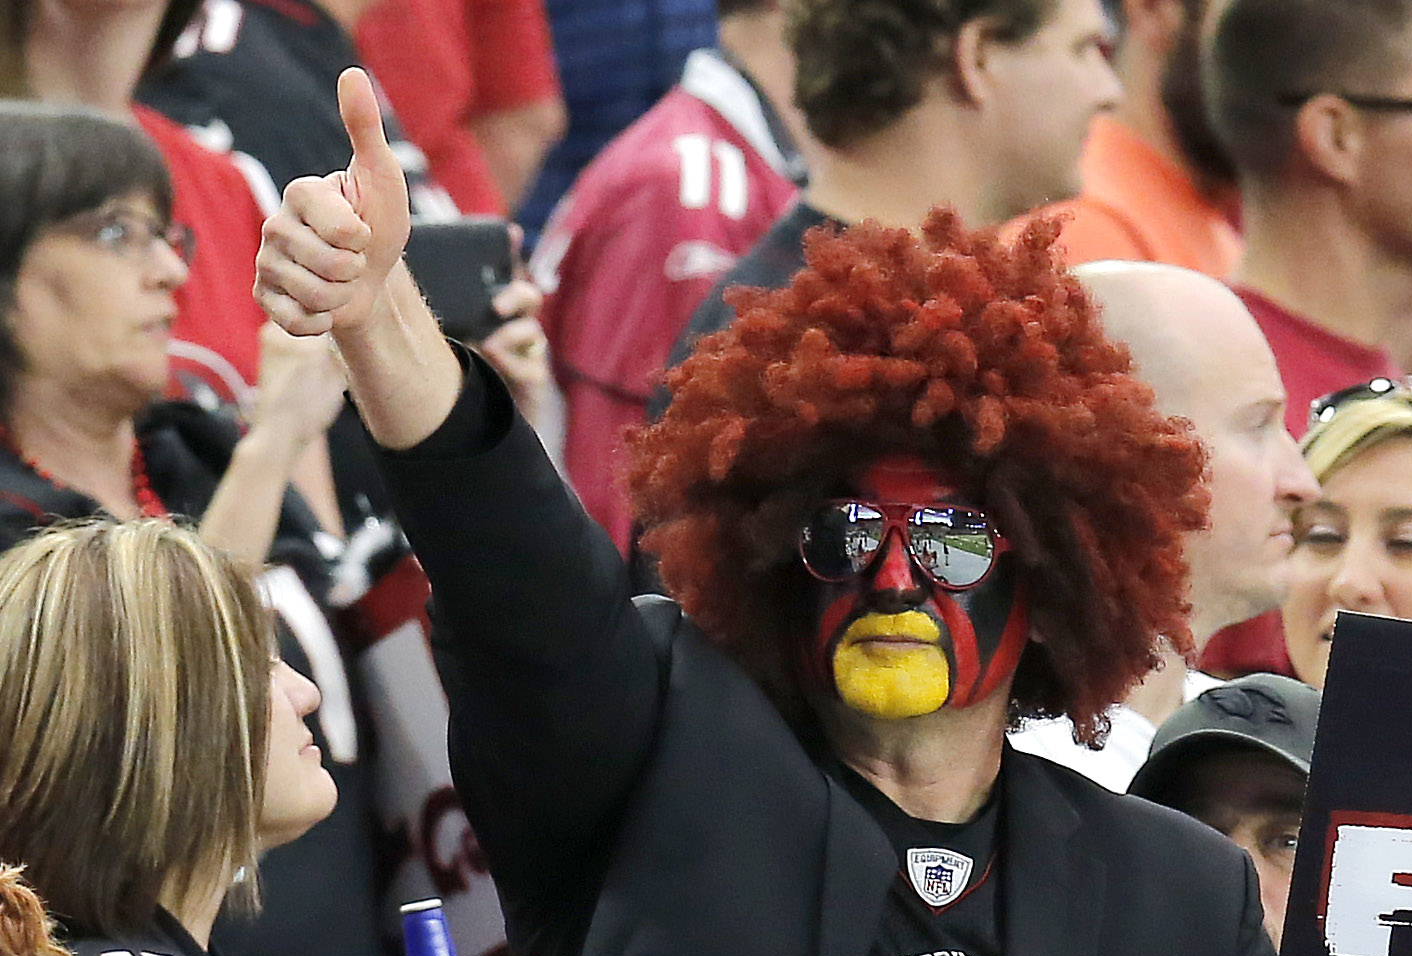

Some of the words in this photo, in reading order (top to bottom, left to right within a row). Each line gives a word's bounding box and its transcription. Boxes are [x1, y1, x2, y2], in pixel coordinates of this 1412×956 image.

[671, 132, 748, 221] 11
[914, 854, 965, 870] EQUIPMENT
[926, 879, 949, 894] NFL
